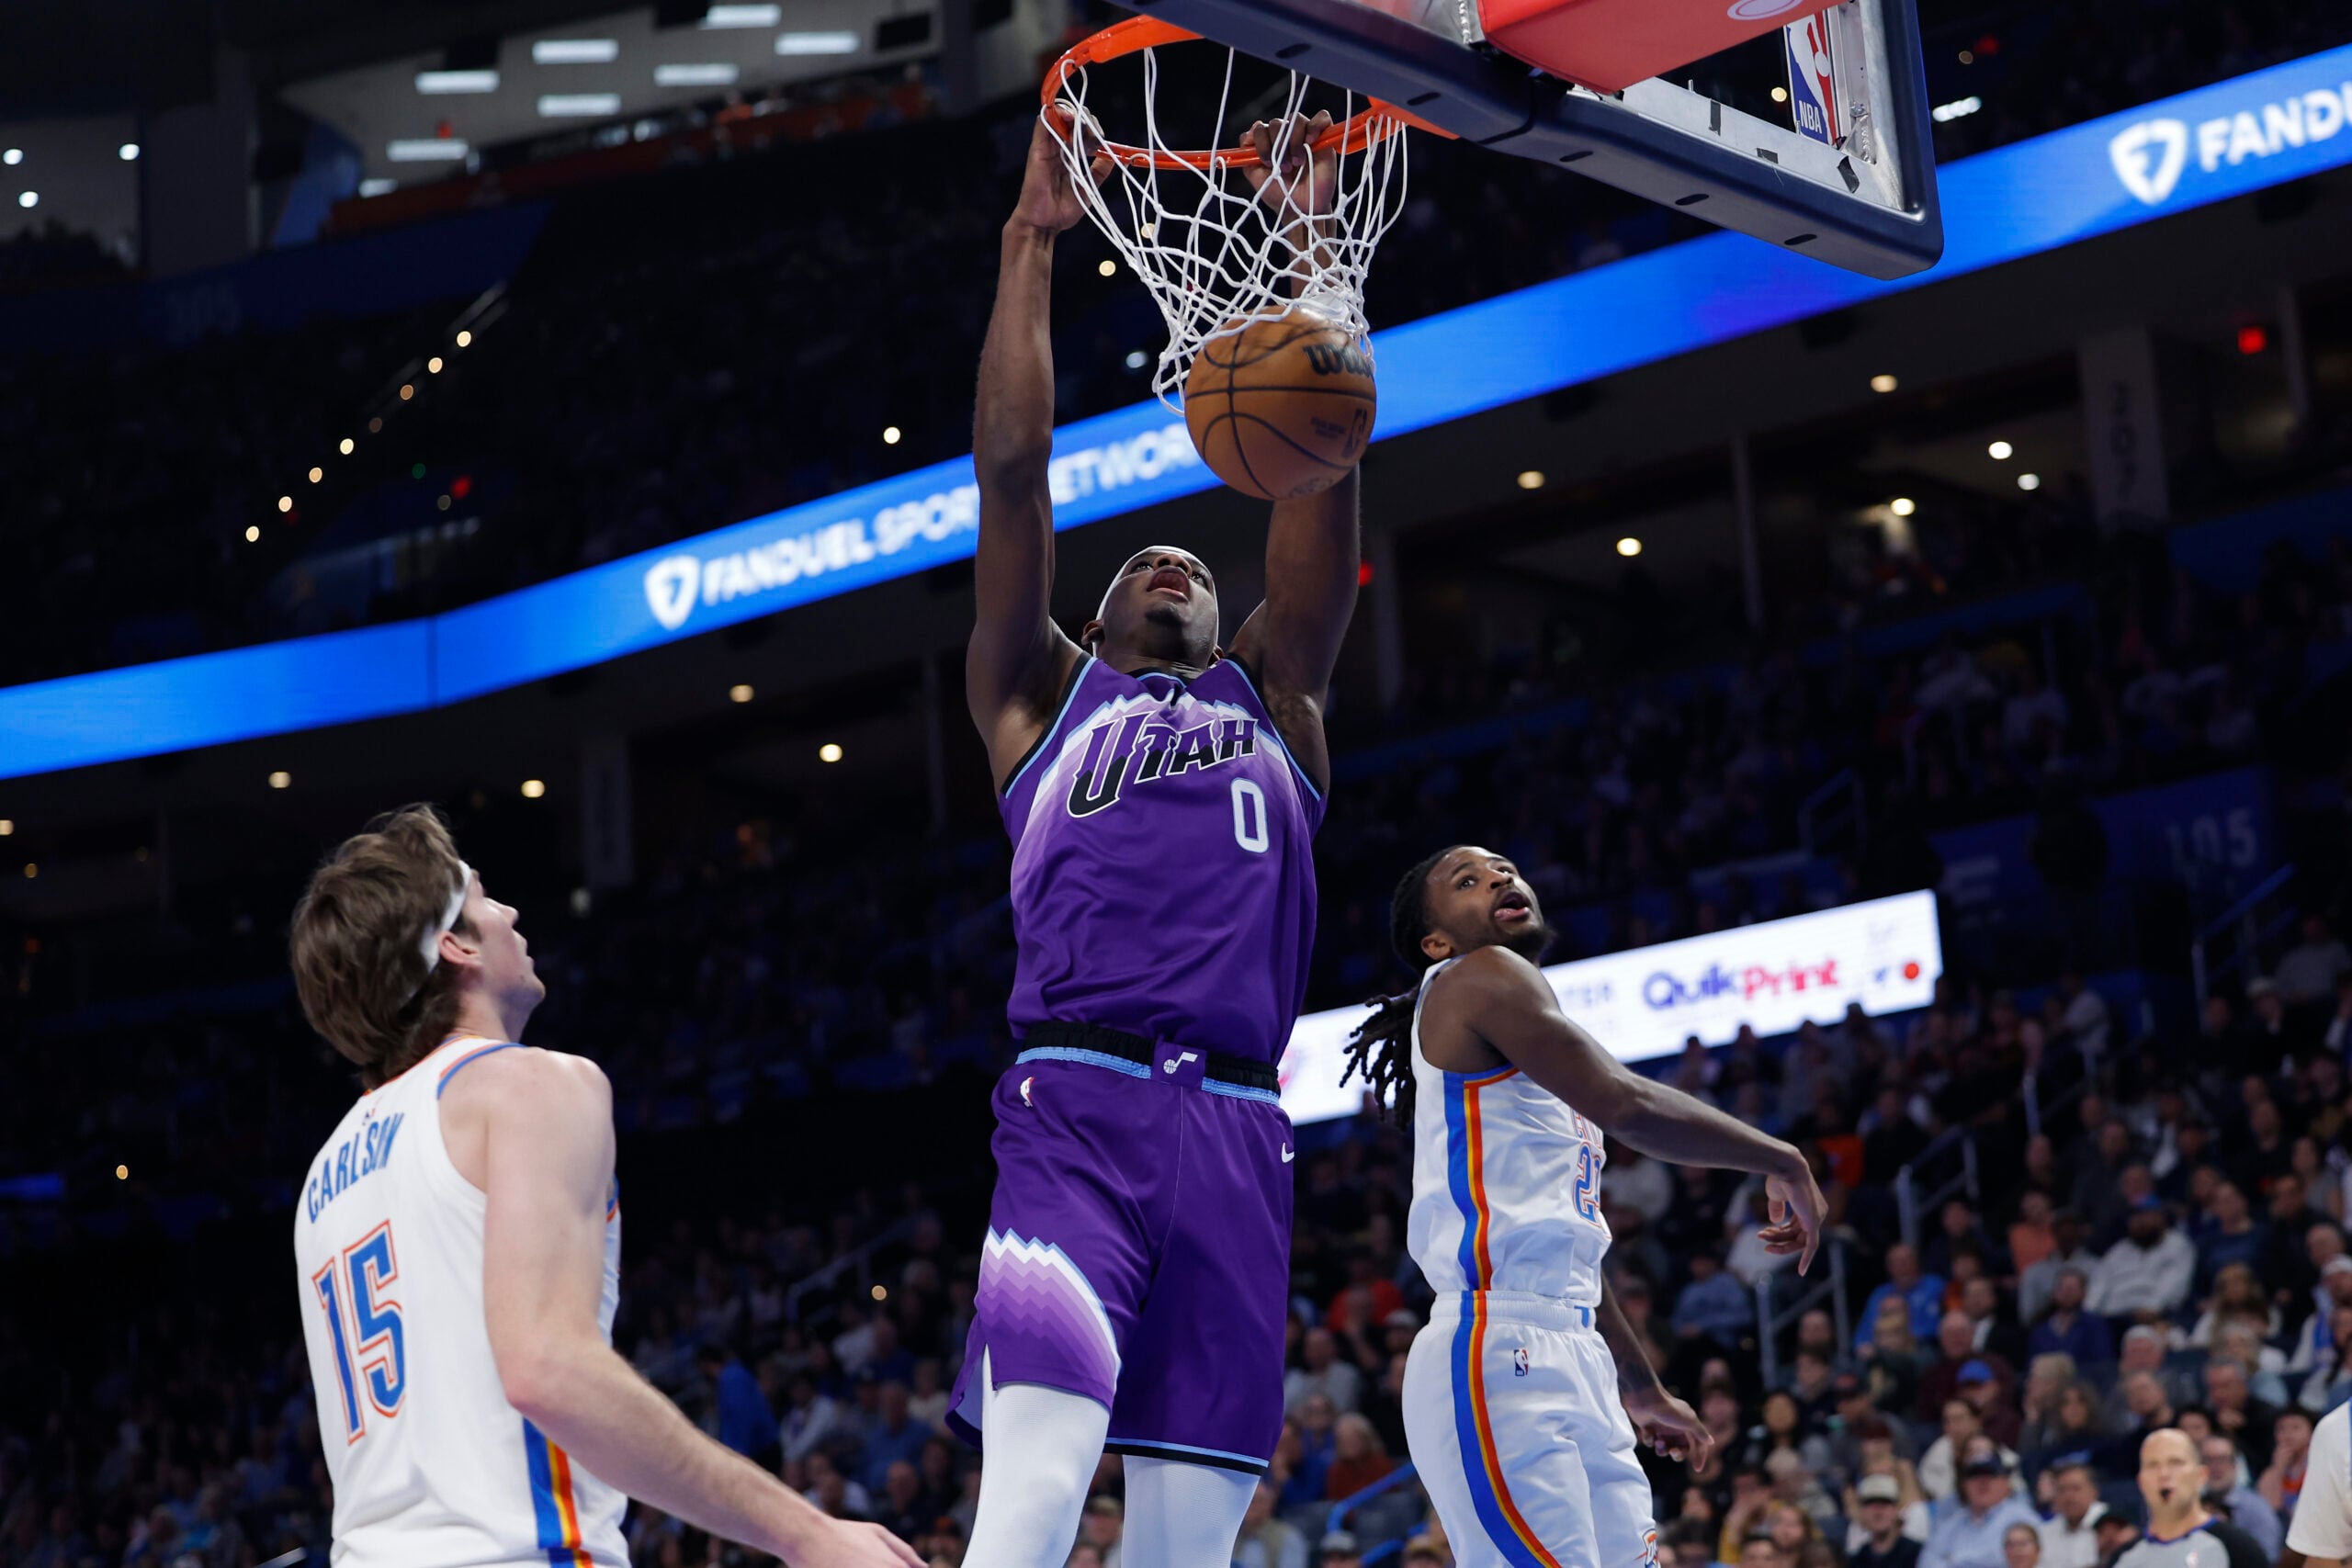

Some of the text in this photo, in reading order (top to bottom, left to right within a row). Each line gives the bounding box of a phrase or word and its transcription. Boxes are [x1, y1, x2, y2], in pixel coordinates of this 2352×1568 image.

[1798, 99, 1823, 134] NBA
[702, 423, 1200, 607] FANDUEL SPOR ETWOR
[1067, 710, 1259, 818] UTAH
[1231, 777, 1269, 853] 0
[311, 1218, 406, 1447] 15
